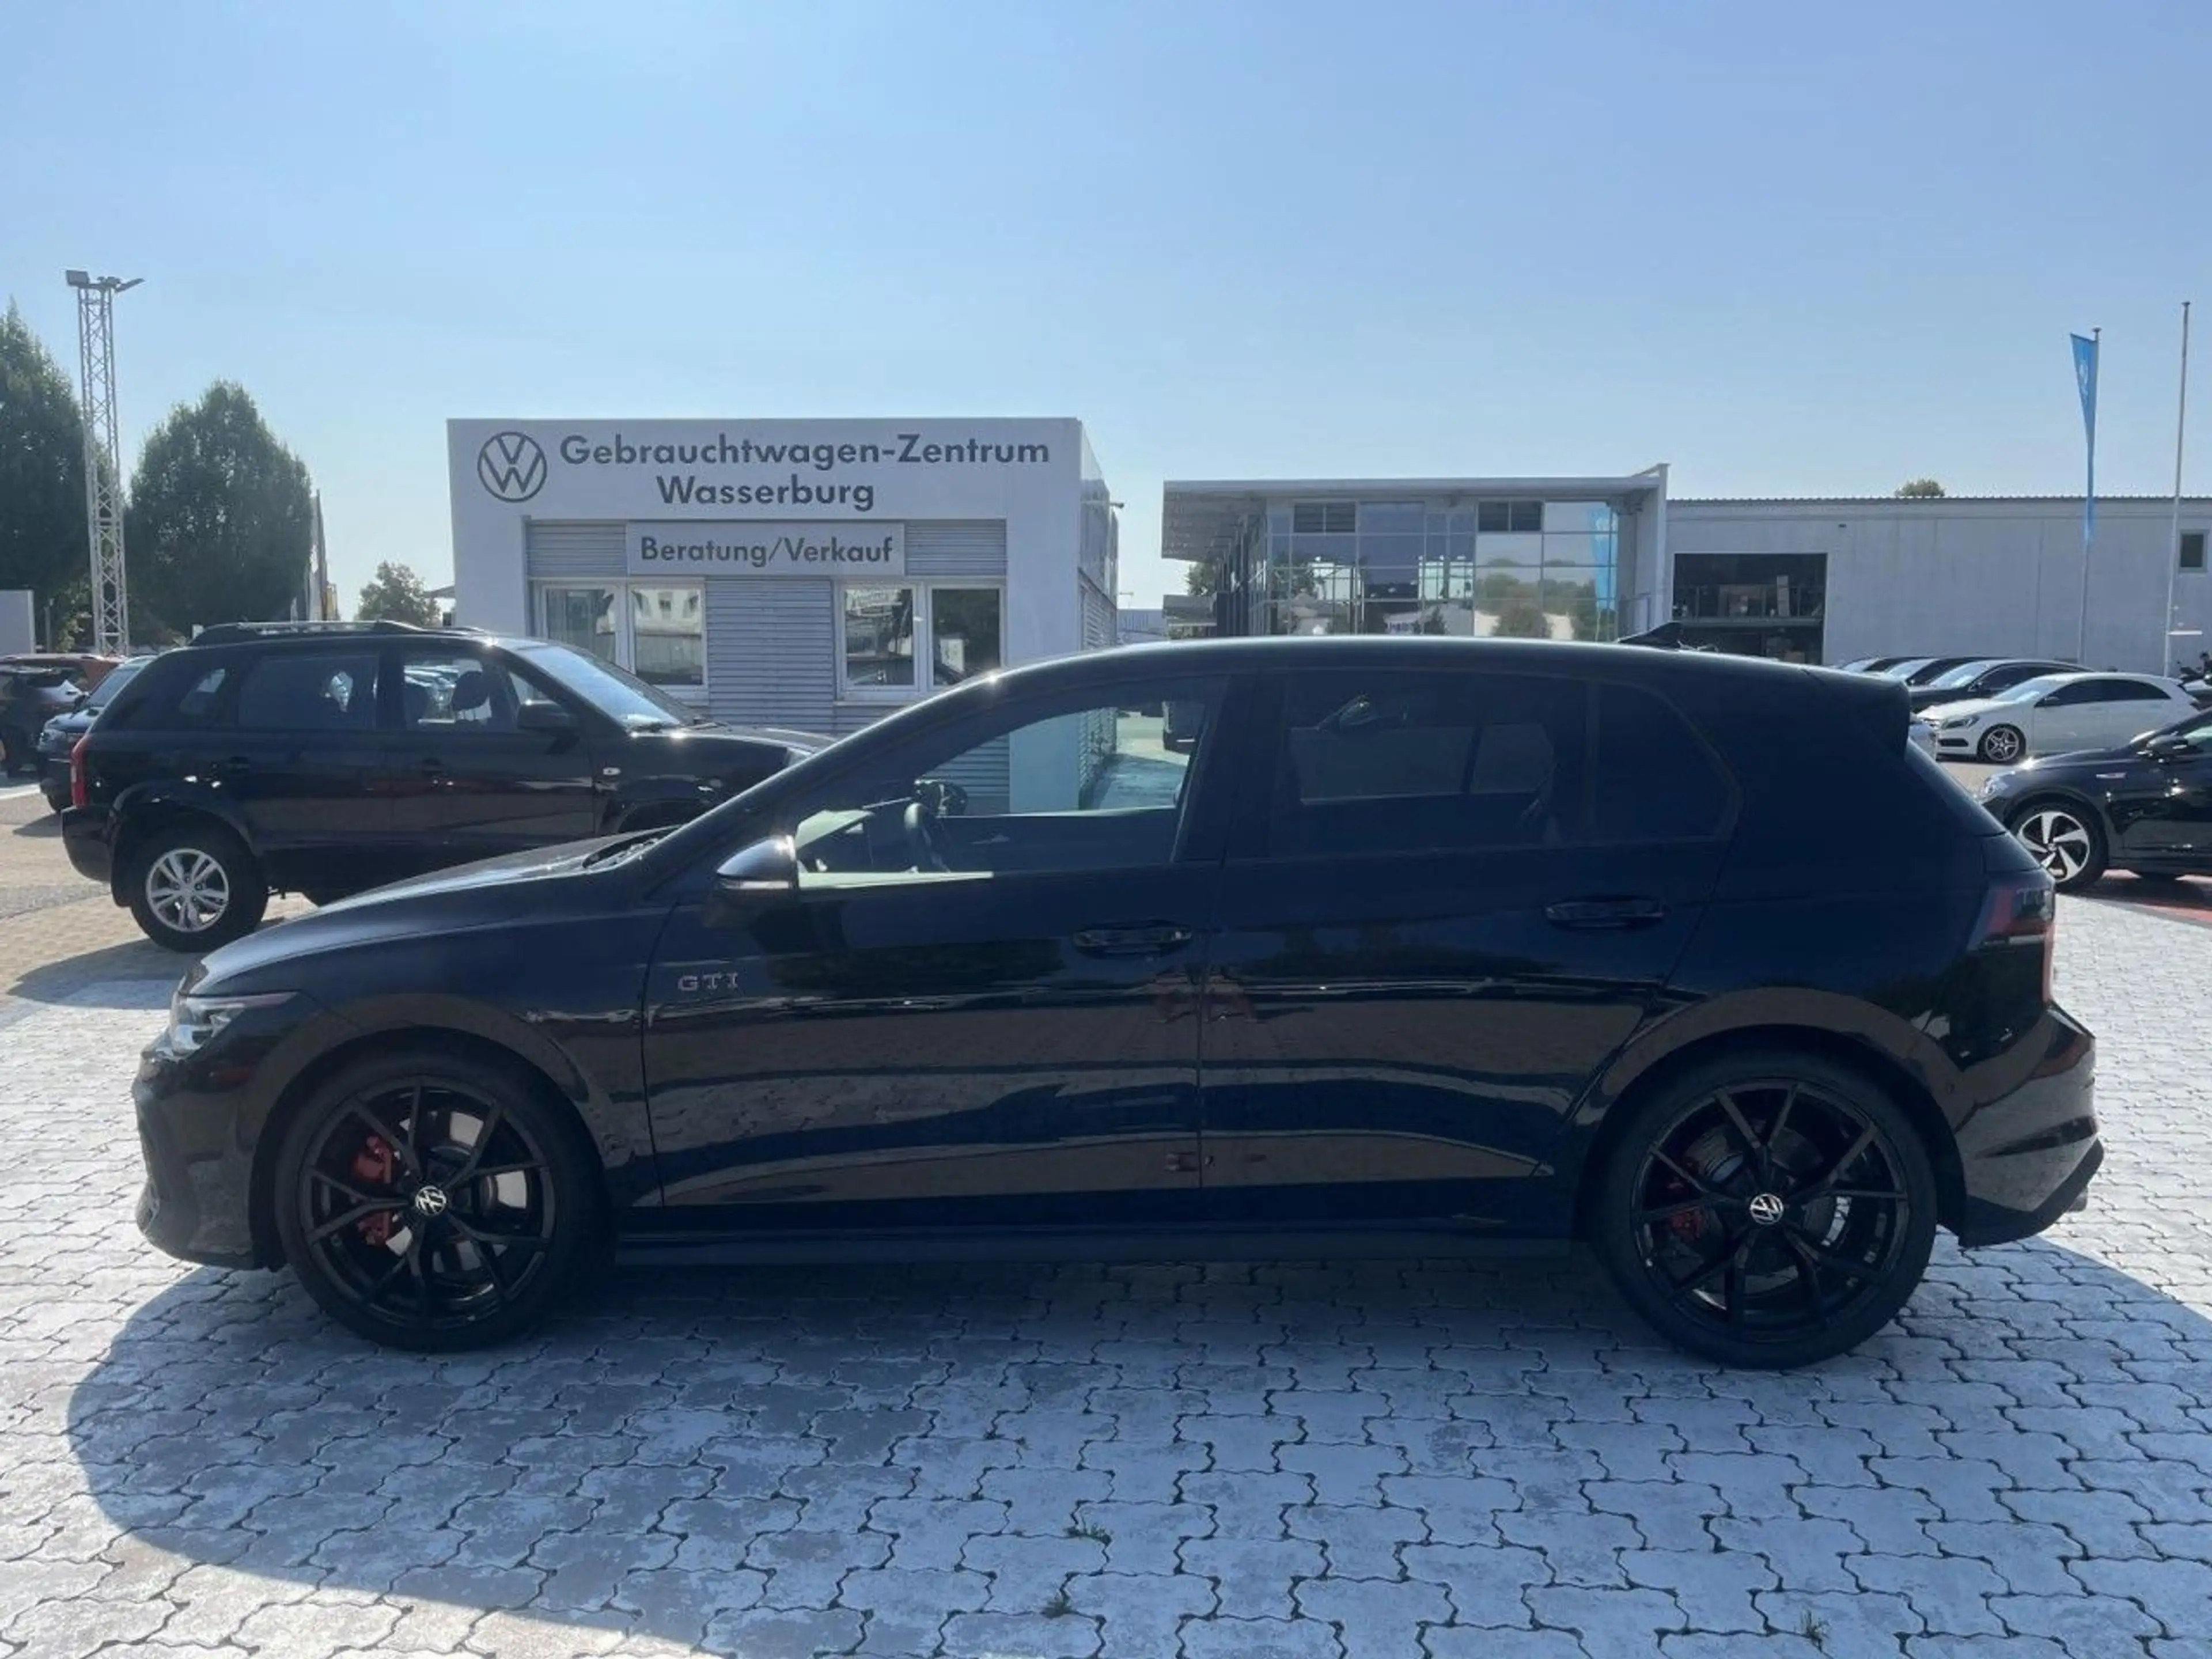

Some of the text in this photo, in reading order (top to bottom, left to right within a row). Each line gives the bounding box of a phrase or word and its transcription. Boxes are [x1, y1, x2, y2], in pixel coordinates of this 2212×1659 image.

[478, 431, 547, 503] VW
[560, 433, 1049, 471] Gebrauchtwagen-Zentrum
[656, 474, 874, 512] Wasserburg
[641, 536, 893, 568] Beratung/Verkauf
[677, 972, 738, 991] GTI
